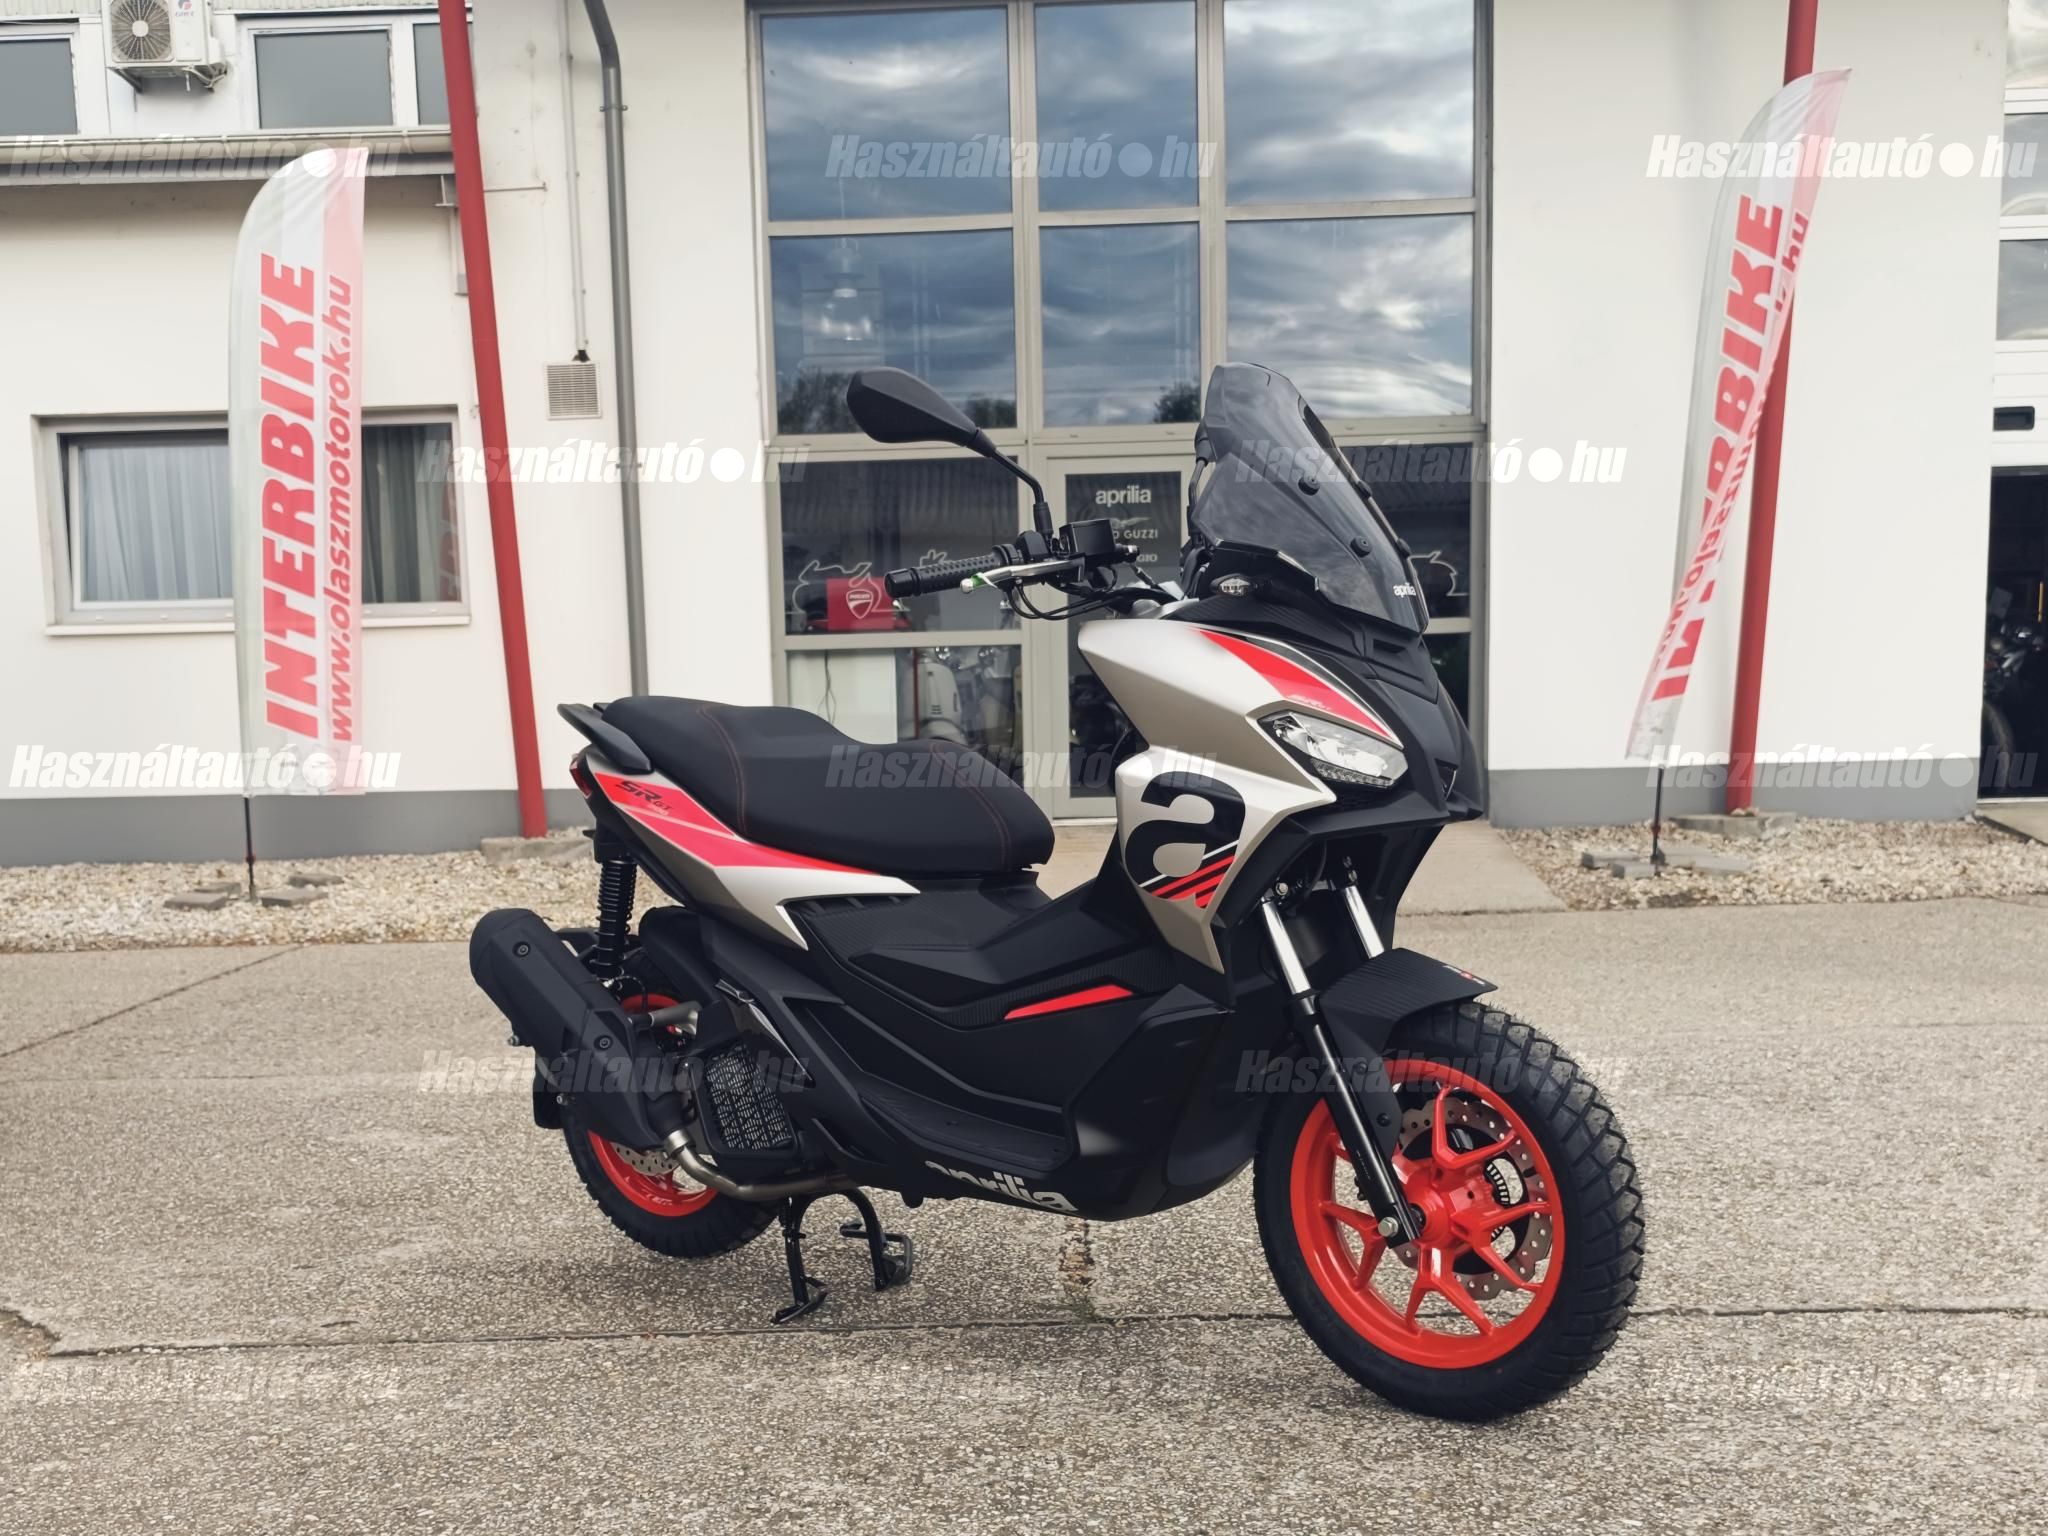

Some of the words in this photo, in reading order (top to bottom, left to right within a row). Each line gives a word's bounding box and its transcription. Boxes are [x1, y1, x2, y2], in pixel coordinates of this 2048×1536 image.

[261, 253, 318, 739] INTERBIKE
[1095, 485, 1152, 508] aprilia
[322, 275, 352, 741] www.olaszmotorok.hu
[1123, 529, 1158, 539] GUZZI
[615, 780, 662, 803] SR
